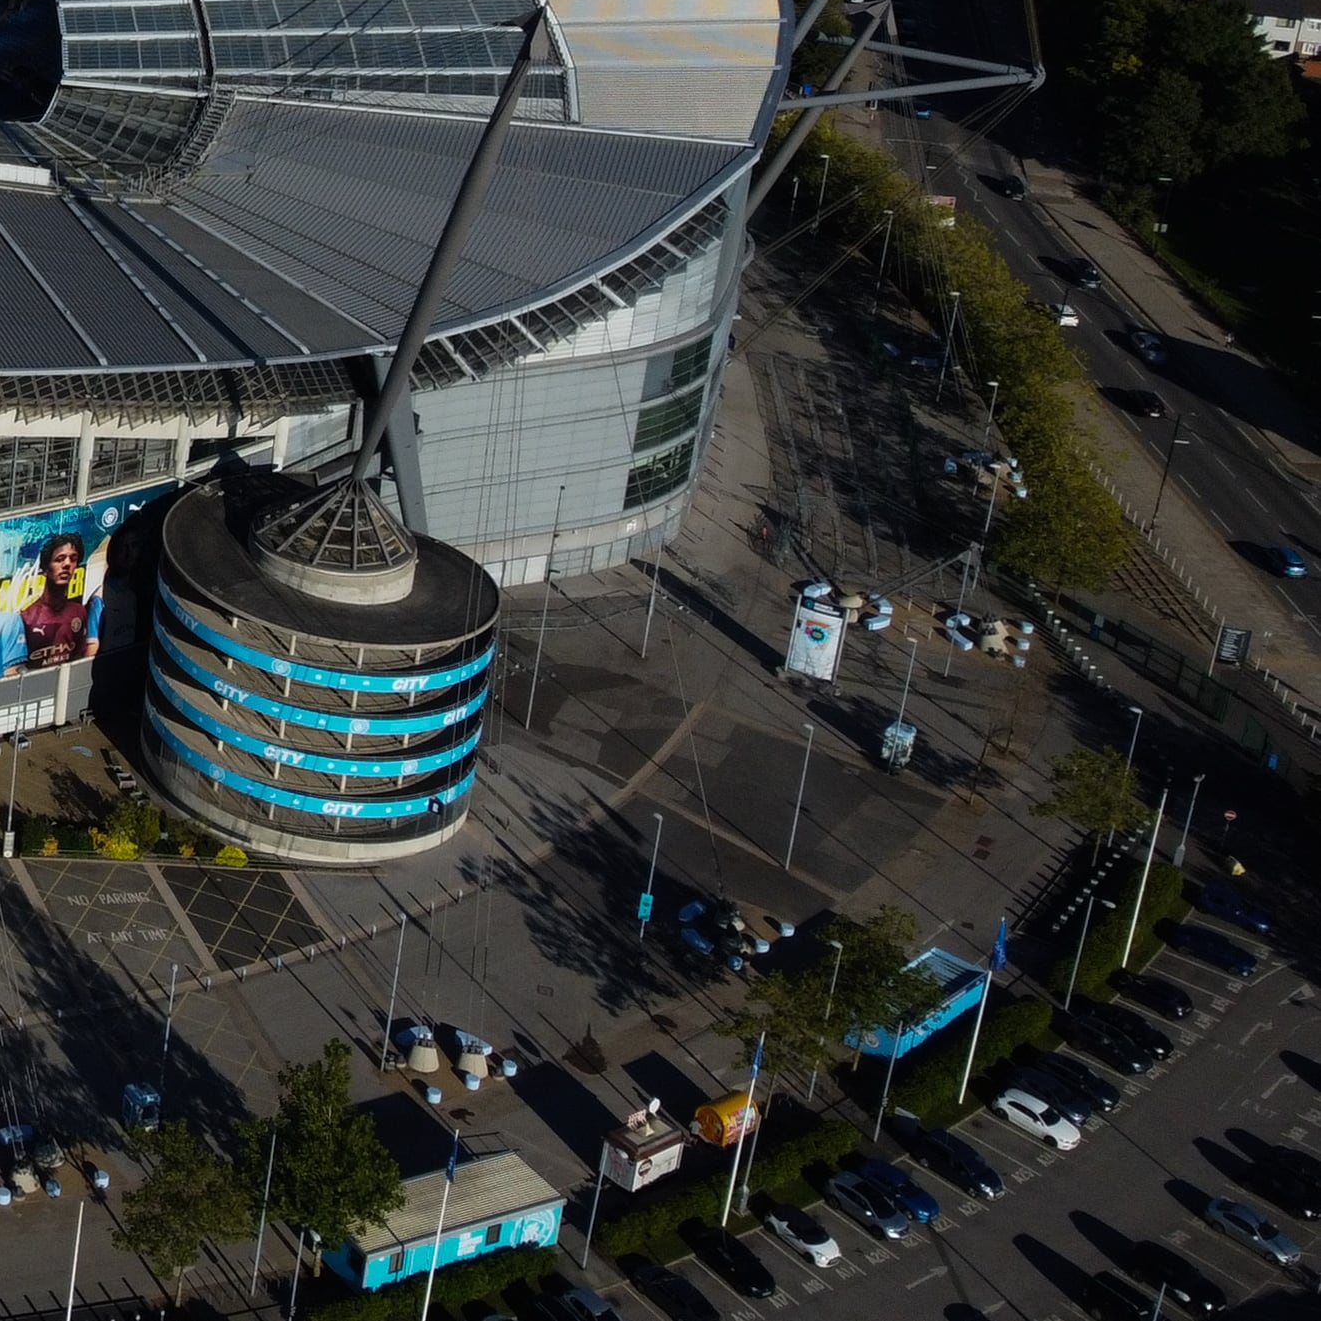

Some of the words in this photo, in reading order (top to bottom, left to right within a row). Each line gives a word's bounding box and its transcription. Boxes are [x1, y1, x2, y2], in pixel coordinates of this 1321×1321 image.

[174, 605, 199, 630] CITY
[29, 643, 77, 661] ETIHAD
[213, 679, 249, 703] CITY
[391, 676, 431, 691] CITY
[443, 707, 468, 725] CITY
[263, 746, 306, 765] CITY
[321, 801, 364, 816] CITY
[67, 894, 90, 907] NO
[98, 891, 151, 905] PARKING
[87, 932, 104, 945] AT
[111, 930, 135, 943] ANY
[138, 929, 170, 942] TIME
